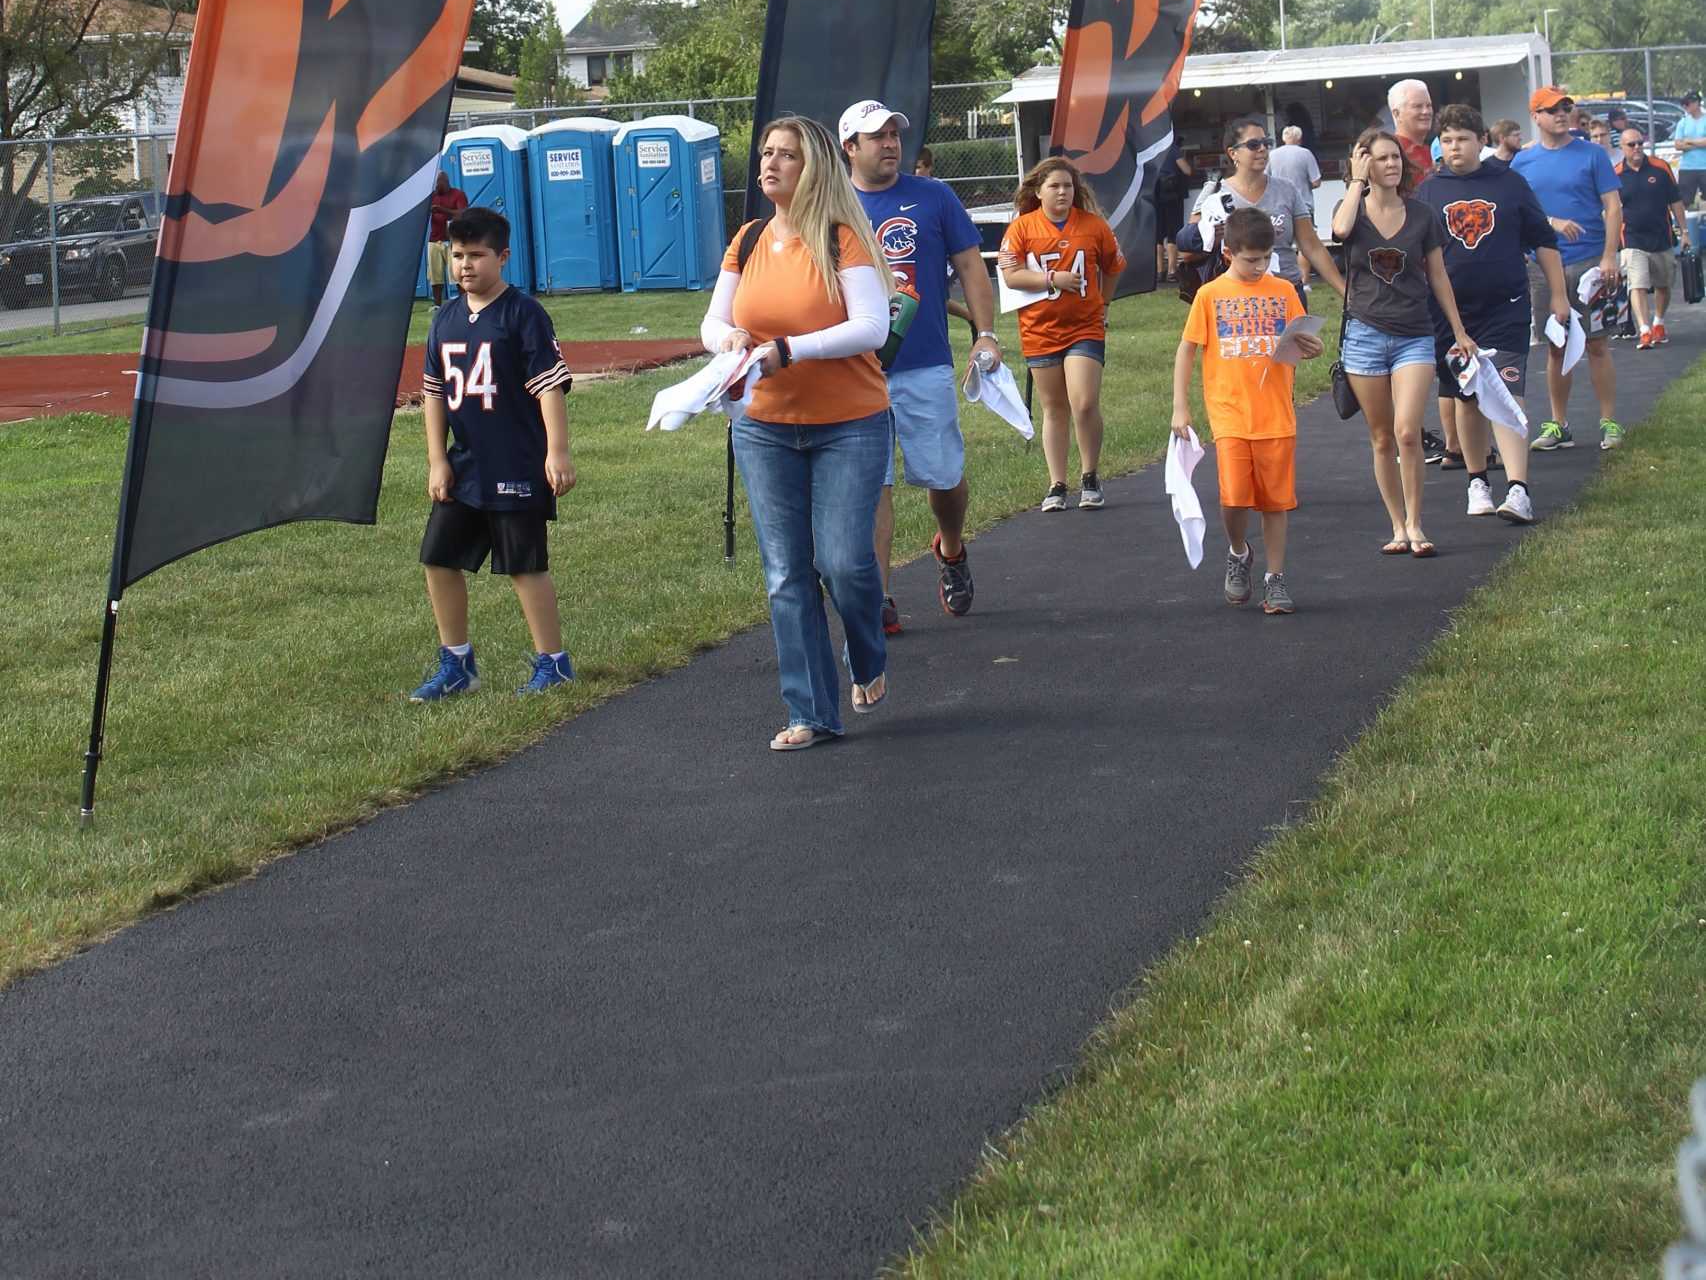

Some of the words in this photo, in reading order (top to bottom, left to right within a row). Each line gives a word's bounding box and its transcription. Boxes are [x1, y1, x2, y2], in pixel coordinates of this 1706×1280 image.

[550, 152, 580, 162] SERVICE
[1230, 319, 1276, 336] THIS
[441, 341, 498, 412] 54
